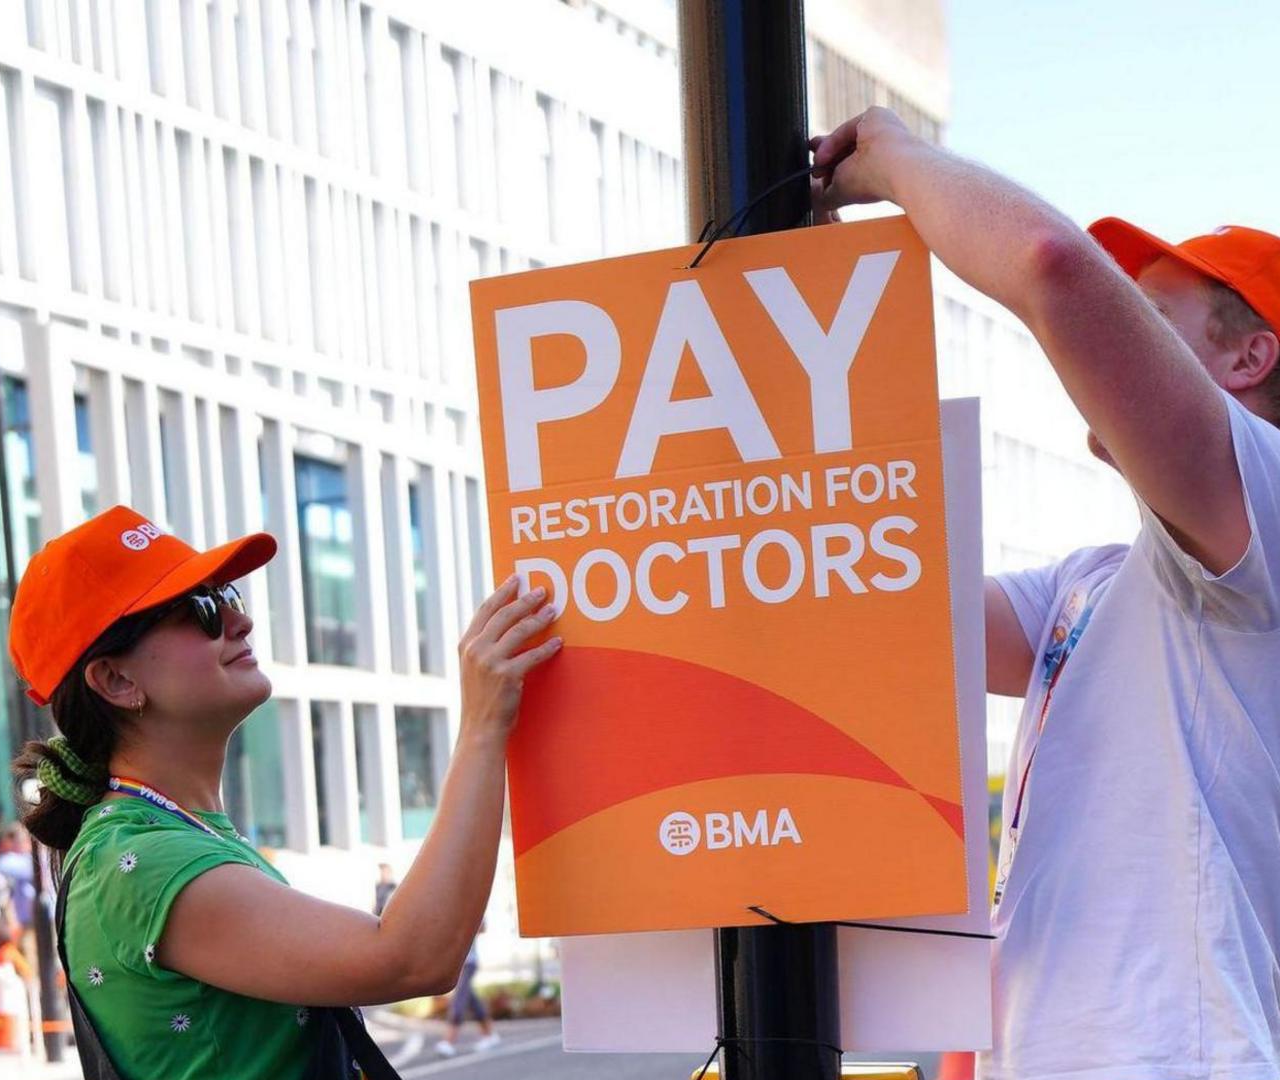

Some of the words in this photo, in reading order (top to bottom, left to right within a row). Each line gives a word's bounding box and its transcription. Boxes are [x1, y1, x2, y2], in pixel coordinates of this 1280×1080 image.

[494, 250, 902, 492] PAY
[511, 472, 812, 544] RESTORATION
[825, 459, 918, 507] FOR
[514, 516, 922, 623] DOCTORS
[703, 808, 802, 850] BMA
